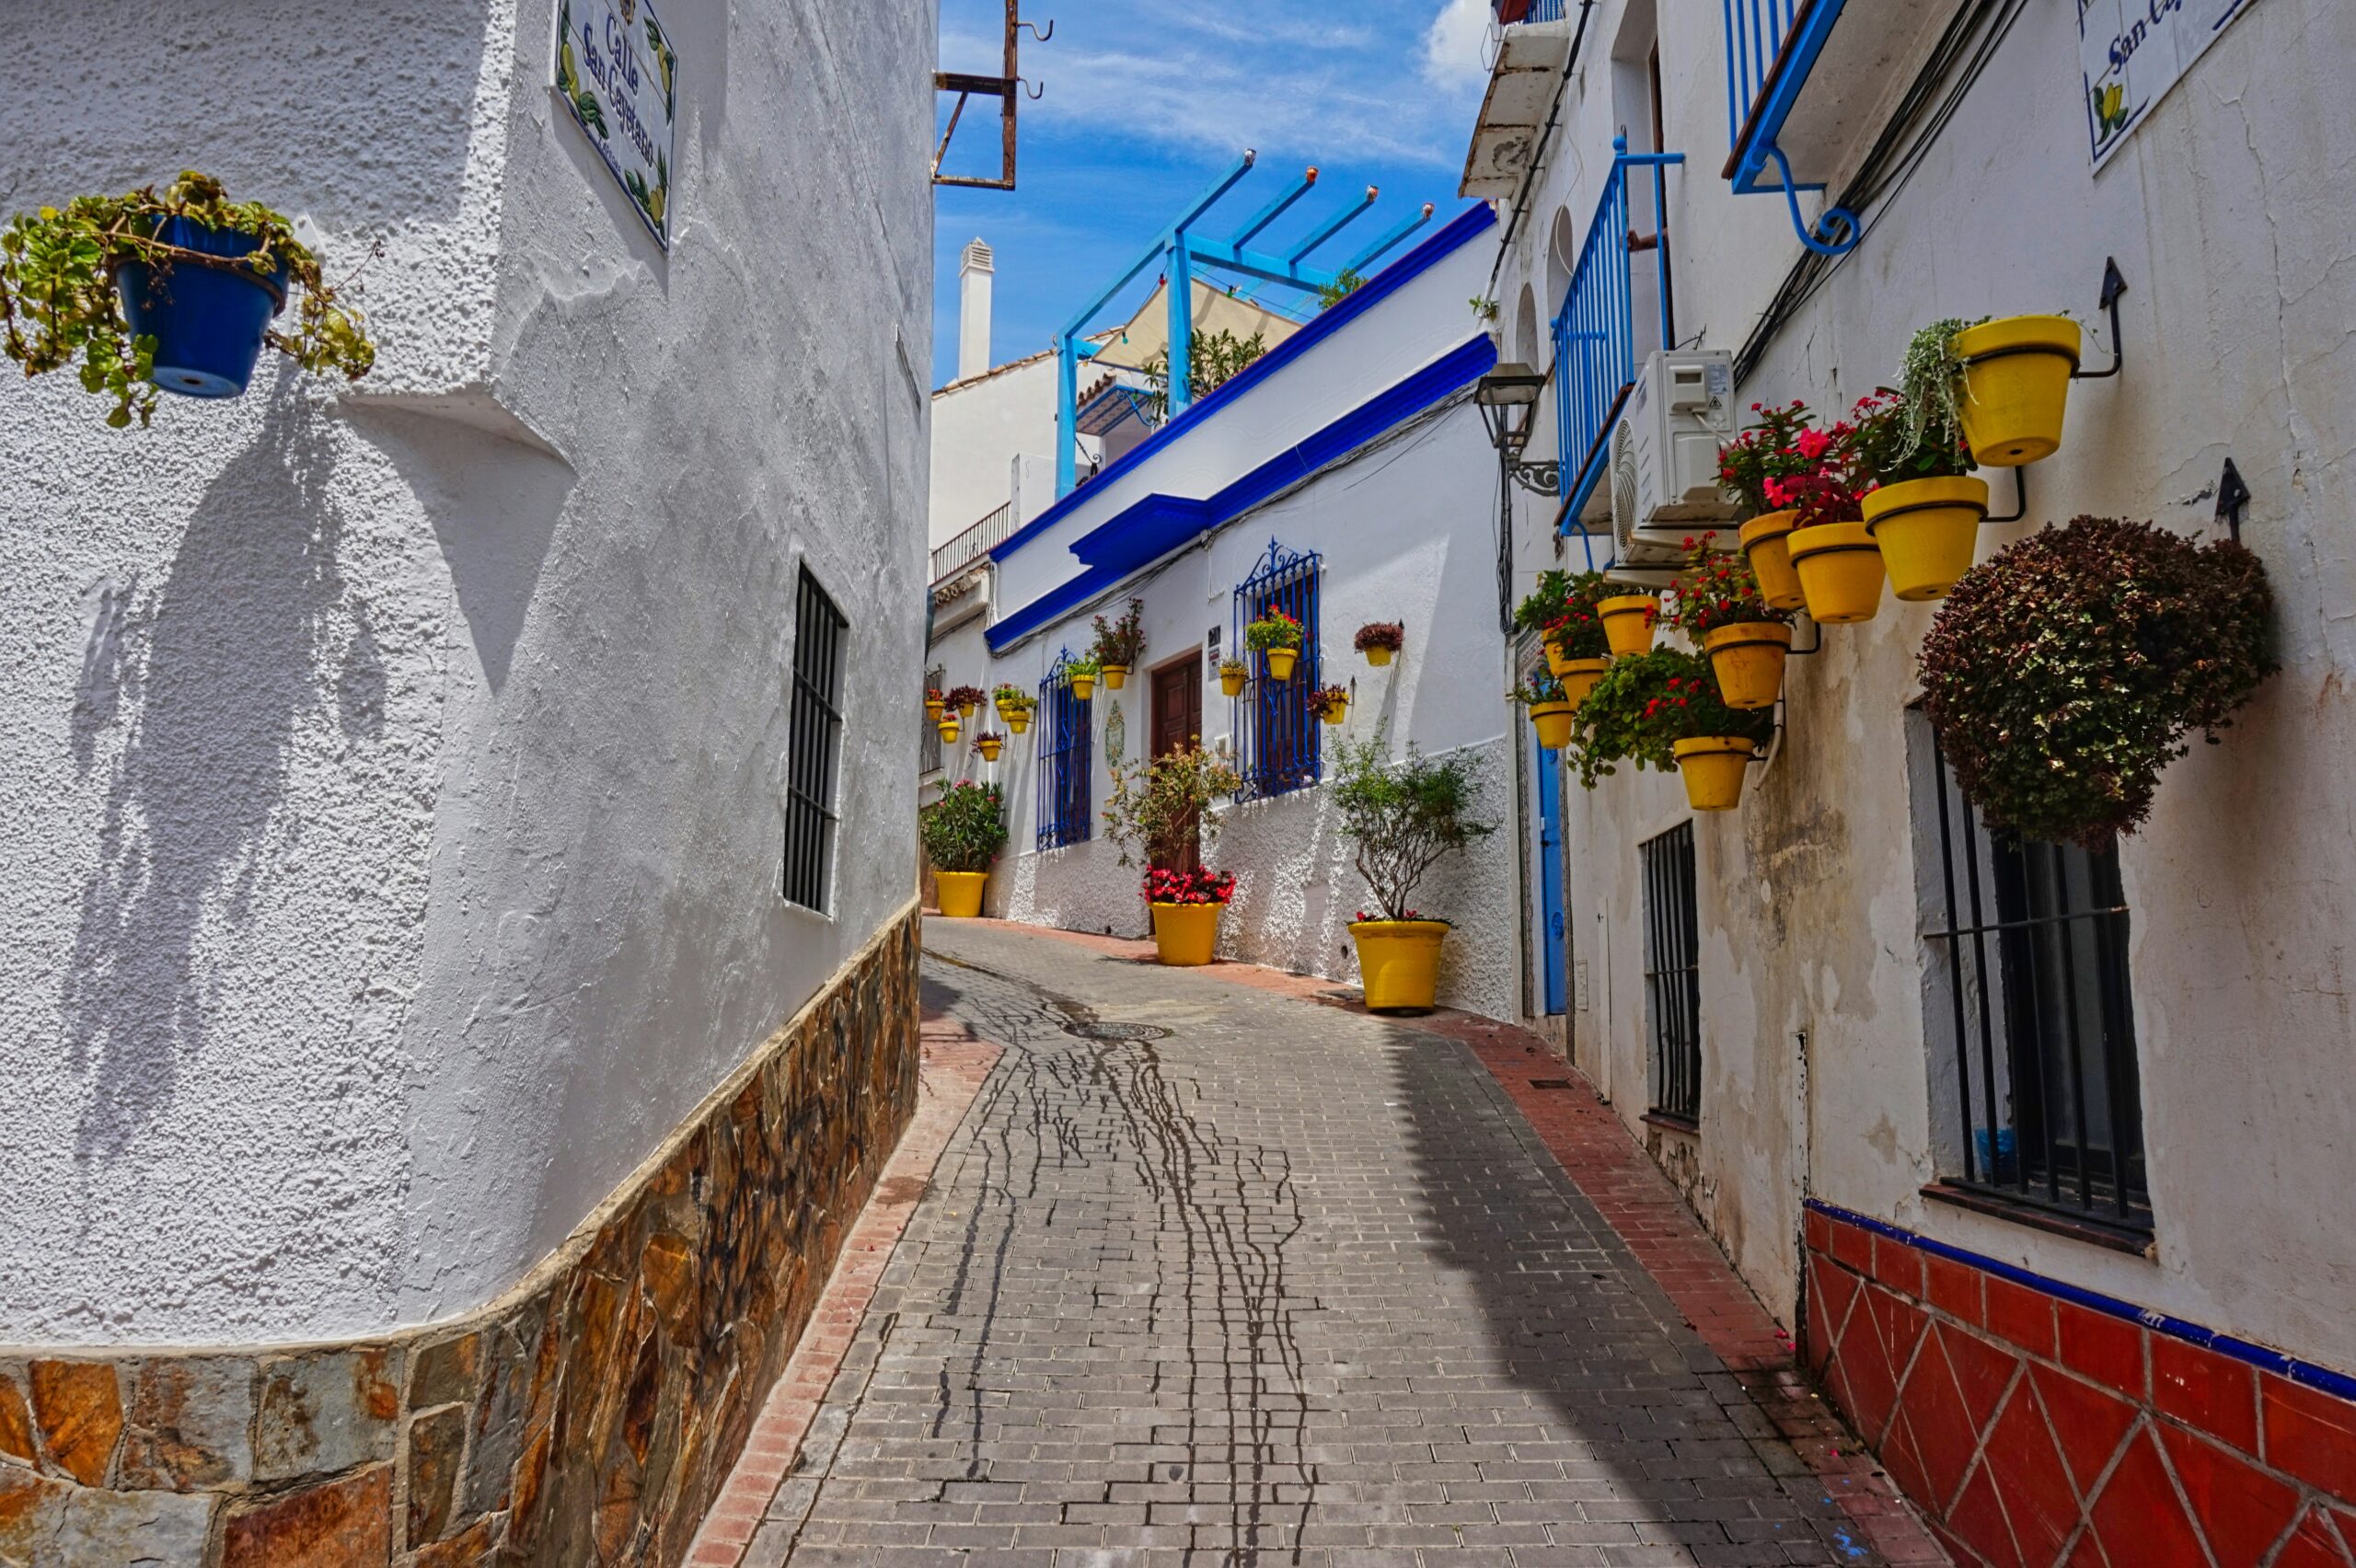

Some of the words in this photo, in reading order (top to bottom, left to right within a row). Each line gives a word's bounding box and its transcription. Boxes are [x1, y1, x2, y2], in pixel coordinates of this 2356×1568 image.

[606, 12, 639, 97] Calle
[2108, 19, 2147, 75] San
[583, 22, 607, 93] San
[607, 67, 654, 167] Cayetano
